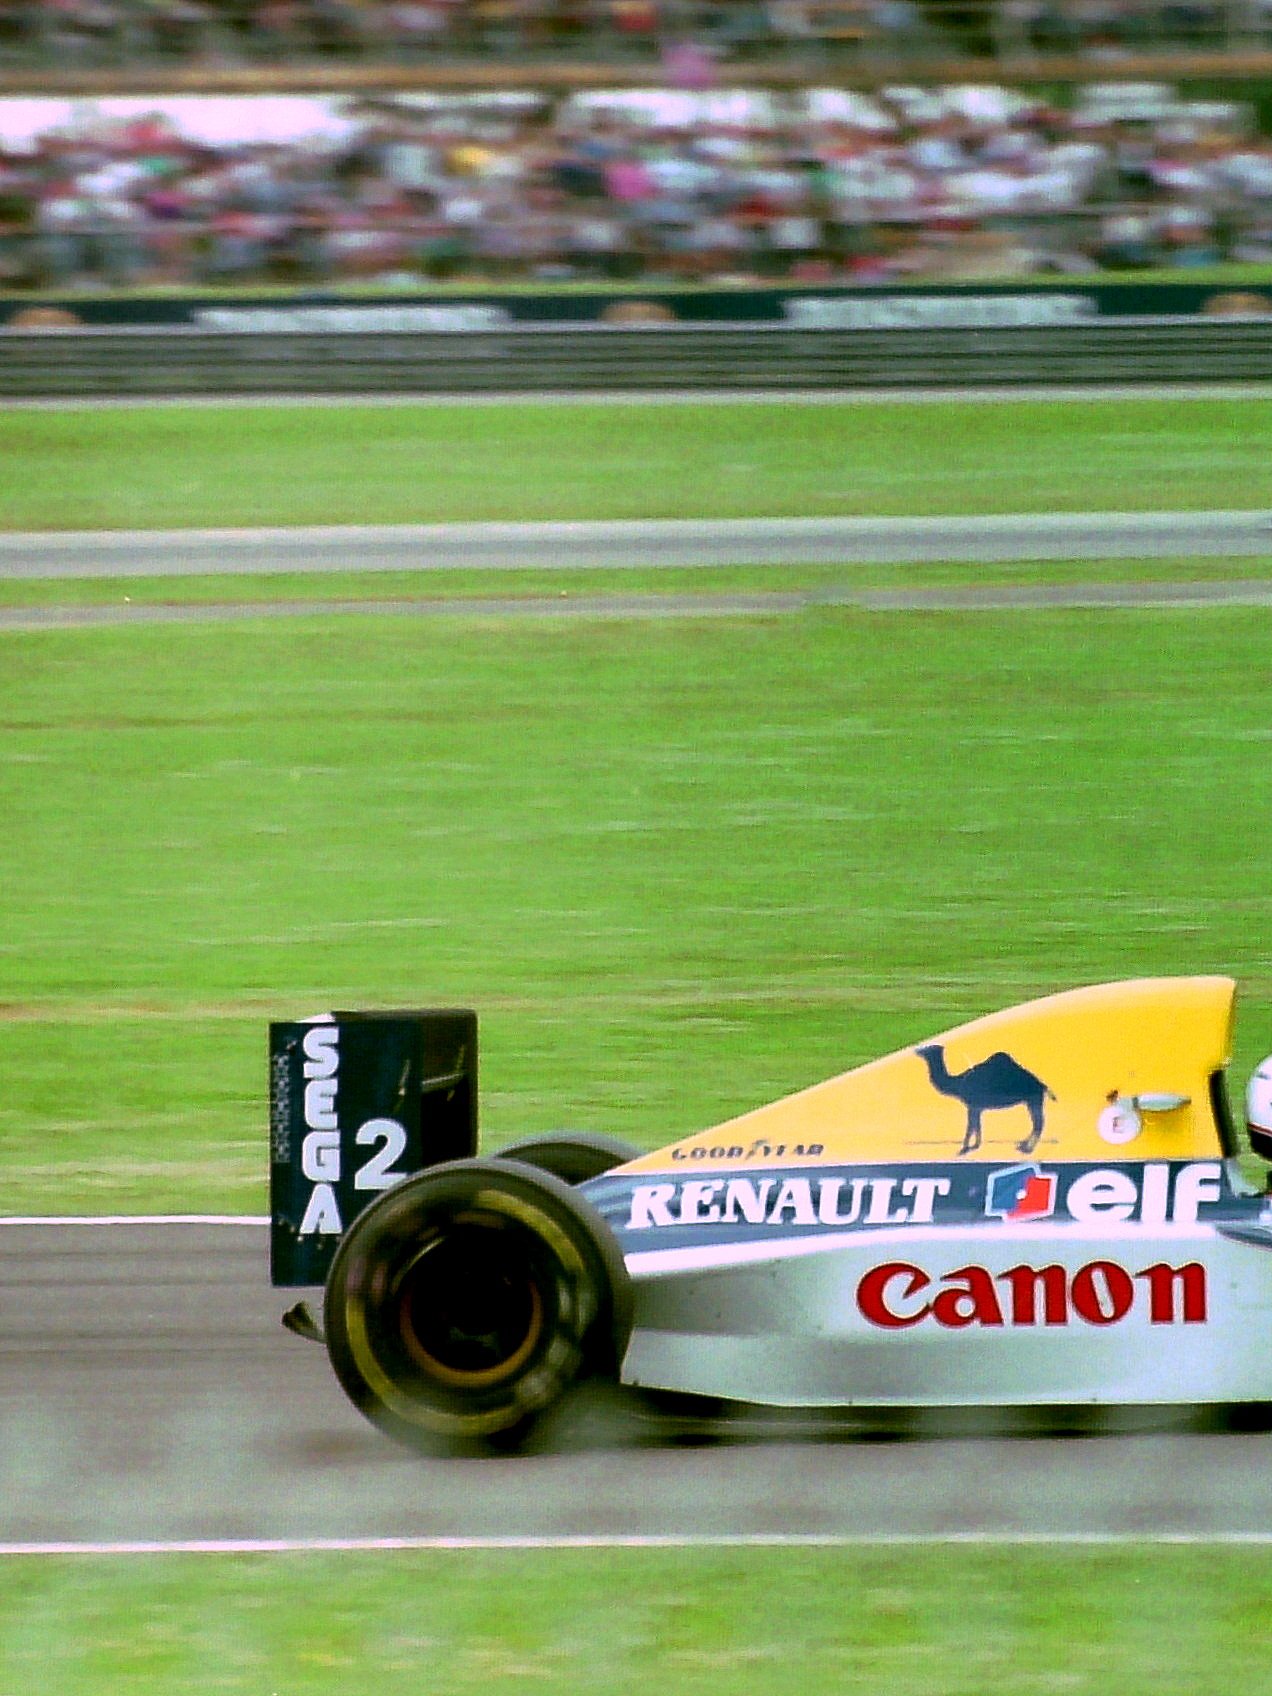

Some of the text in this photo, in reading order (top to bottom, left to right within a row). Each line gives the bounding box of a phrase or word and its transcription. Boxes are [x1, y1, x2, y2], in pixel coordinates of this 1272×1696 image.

[301, 1026, 343, 1233] SEGA
[355, 1118, 407, 1190] 2
[626, 1177, 949, 1229] RENAULT
[1067, 1163, 1221, 1222] elf
[856, 1260, 1207, 1328] Canon
